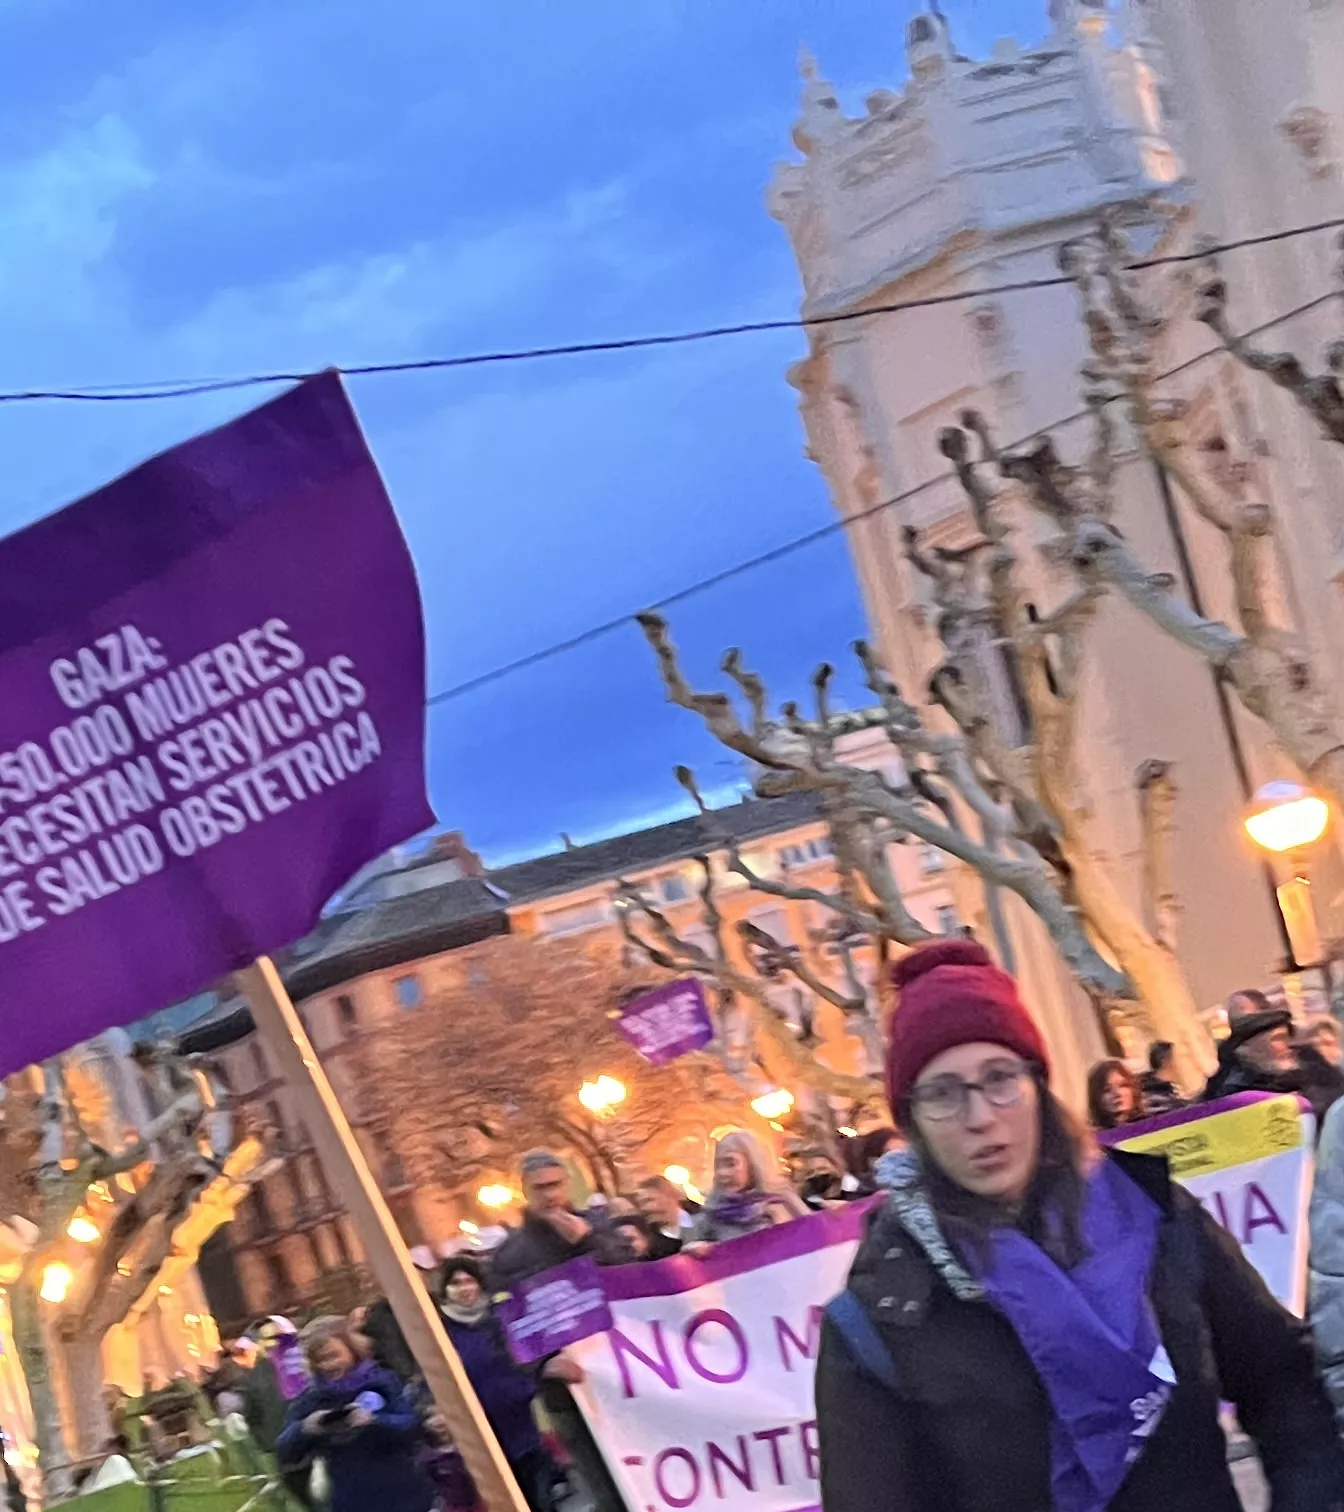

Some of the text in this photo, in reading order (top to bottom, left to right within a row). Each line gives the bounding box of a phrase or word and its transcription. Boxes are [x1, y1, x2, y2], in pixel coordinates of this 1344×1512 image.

[50, 624, 168, 708] GAZA:
[125, 617, 304, 741] MUJERES
[158, 655, 365, 791] SERVICIOS
[36, 823, 164, 915] SALUD
[160, 711, 381, 858] OBSTETRICA
[607, 1308, 748, 1398] NO
